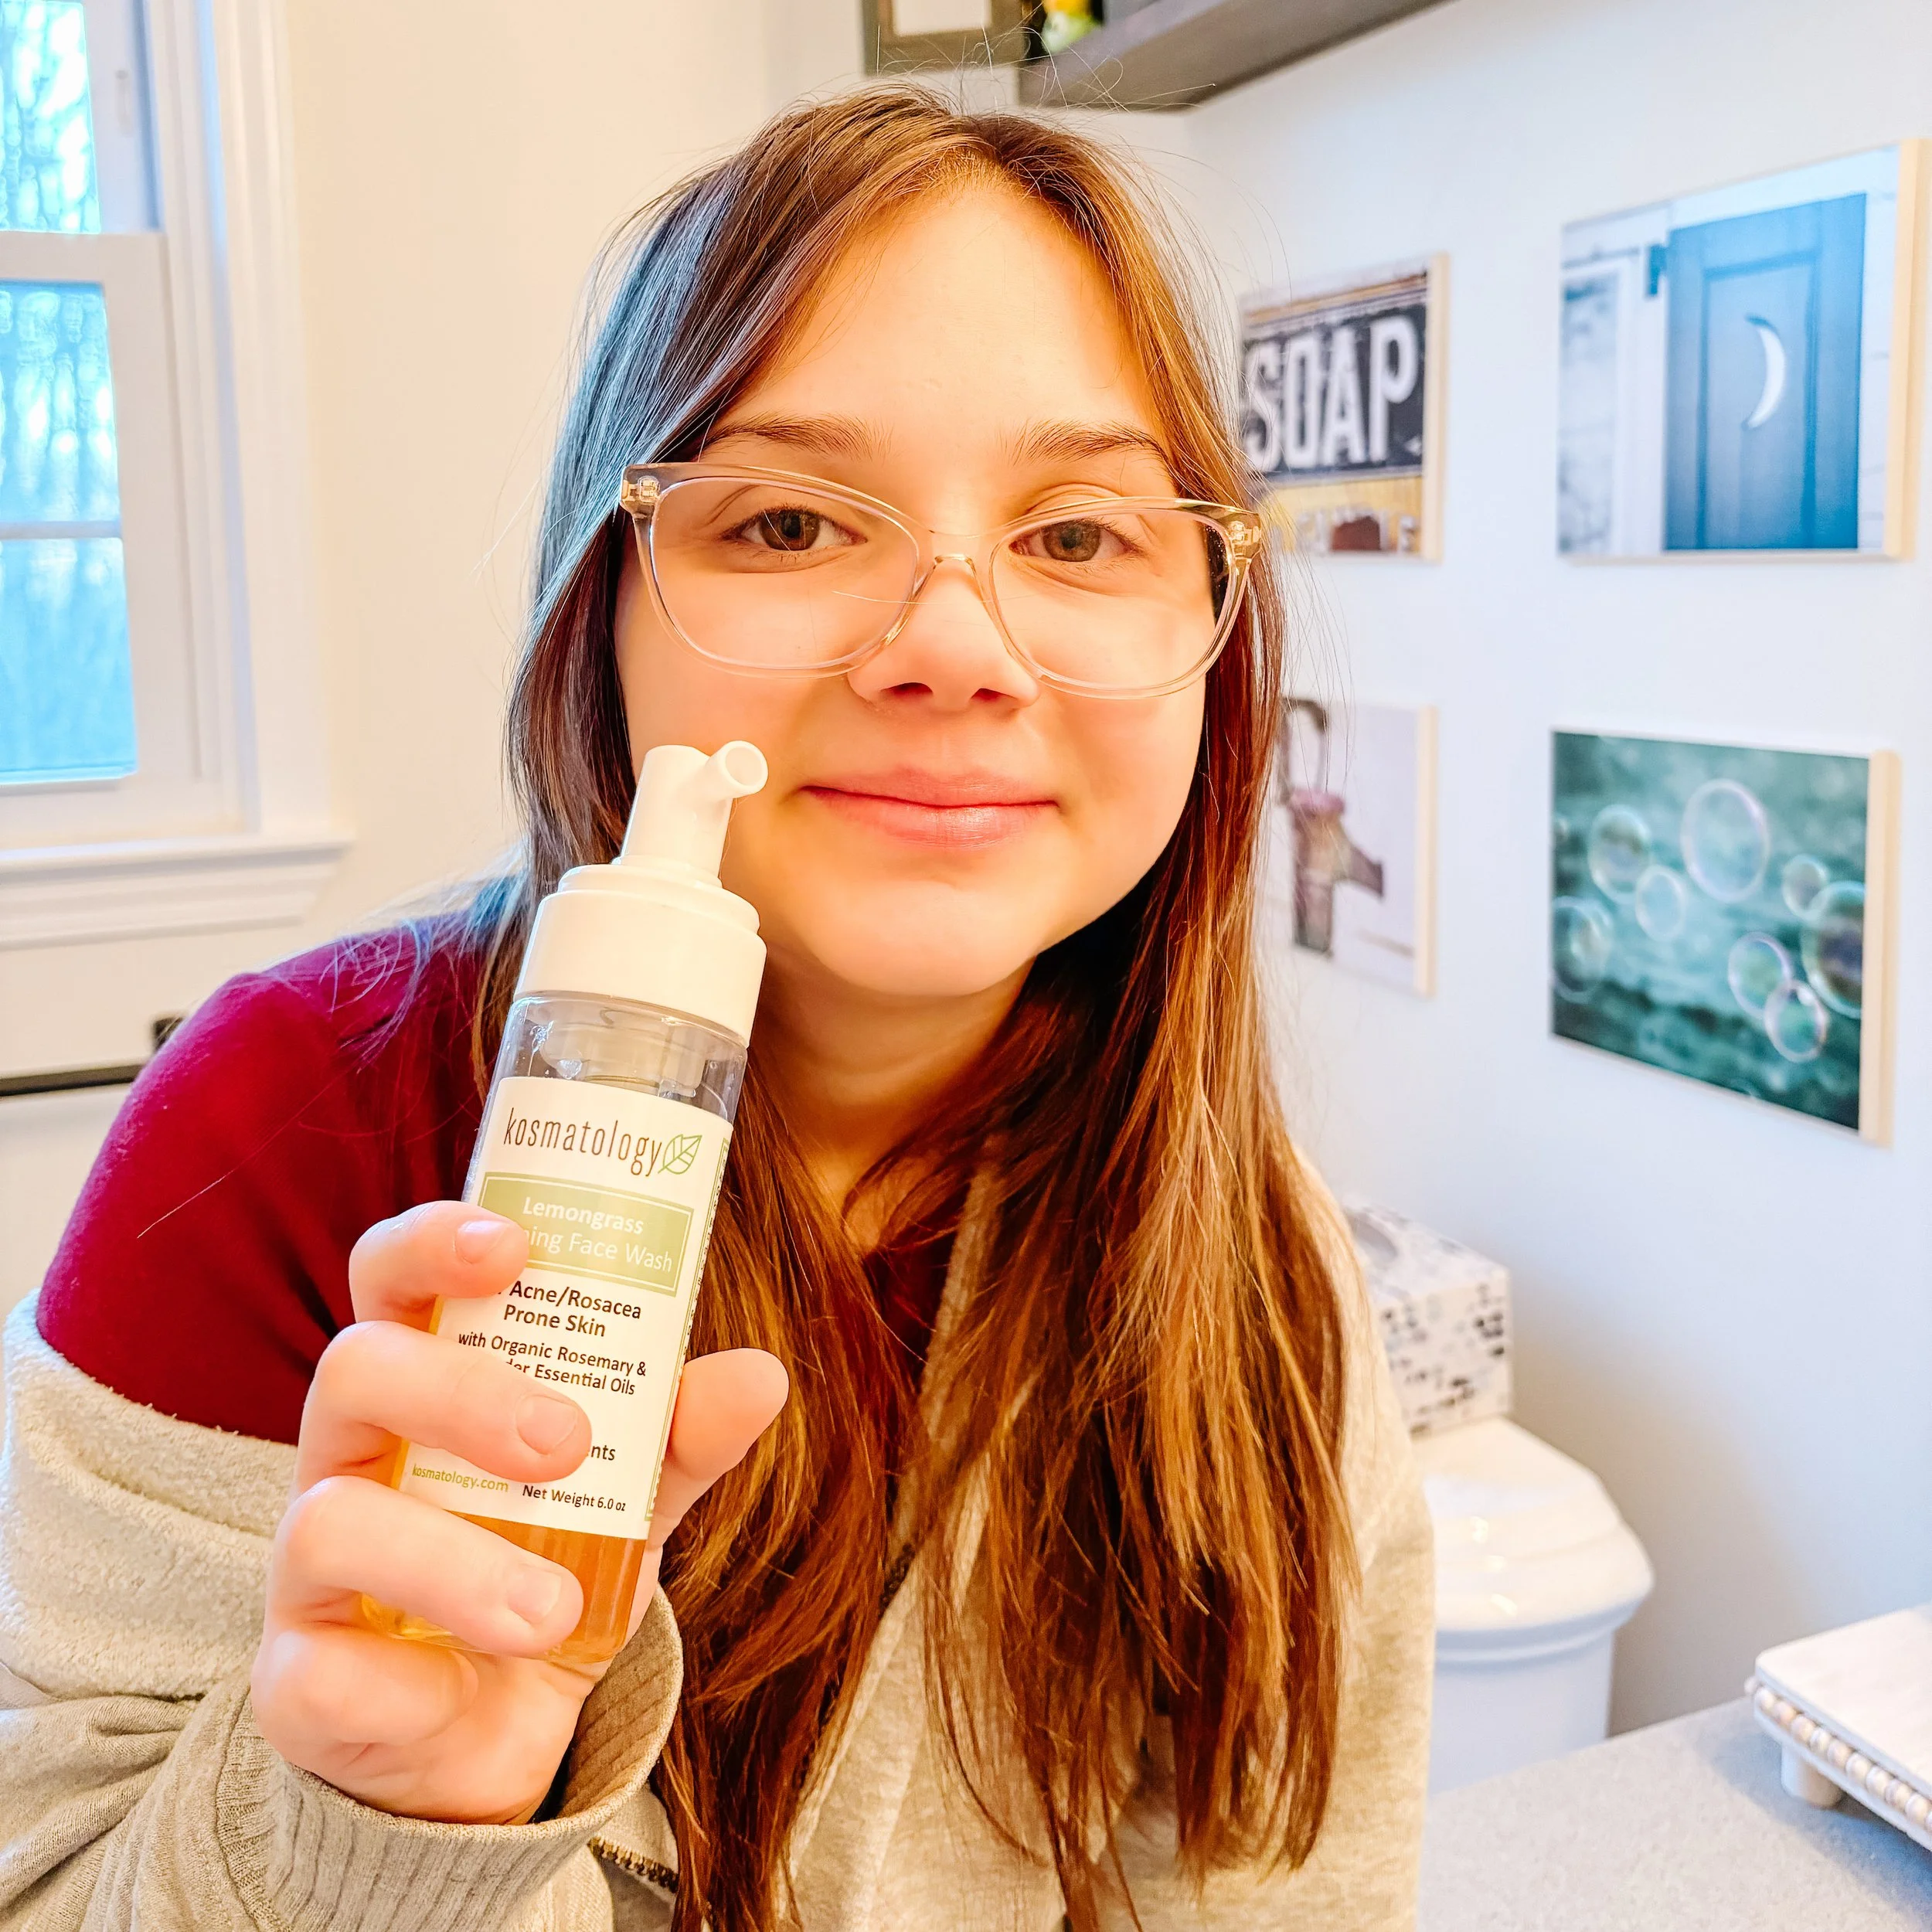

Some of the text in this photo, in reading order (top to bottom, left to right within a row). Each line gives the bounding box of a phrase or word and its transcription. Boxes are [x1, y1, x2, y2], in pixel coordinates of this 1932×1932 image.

[1243, 316, 1418, 472] SOAP
[503, 1107, 662, 1177] kosmatology
[522, 1197, 644, 1235] Lemongrass
[568, 1232, 618, 1260] Face
[625, 1243, 673, 1273] Wash
[509, 1280, 641, 1320] Acne/Rosacea
[503, 1304, 606, 1338] Prone Skin
[458, 1332, 647, 1377] with Organic Rosemary &
[534, 1363, 607, 1389] Essential
[611, 1378, 636, 1396] Oils
[587, 1444, 616, 1461] nts
[412, 1464, 510, 1493] kosmatology.com
[522, 1484, 627, 1512] Net Weight 6.0 oz
